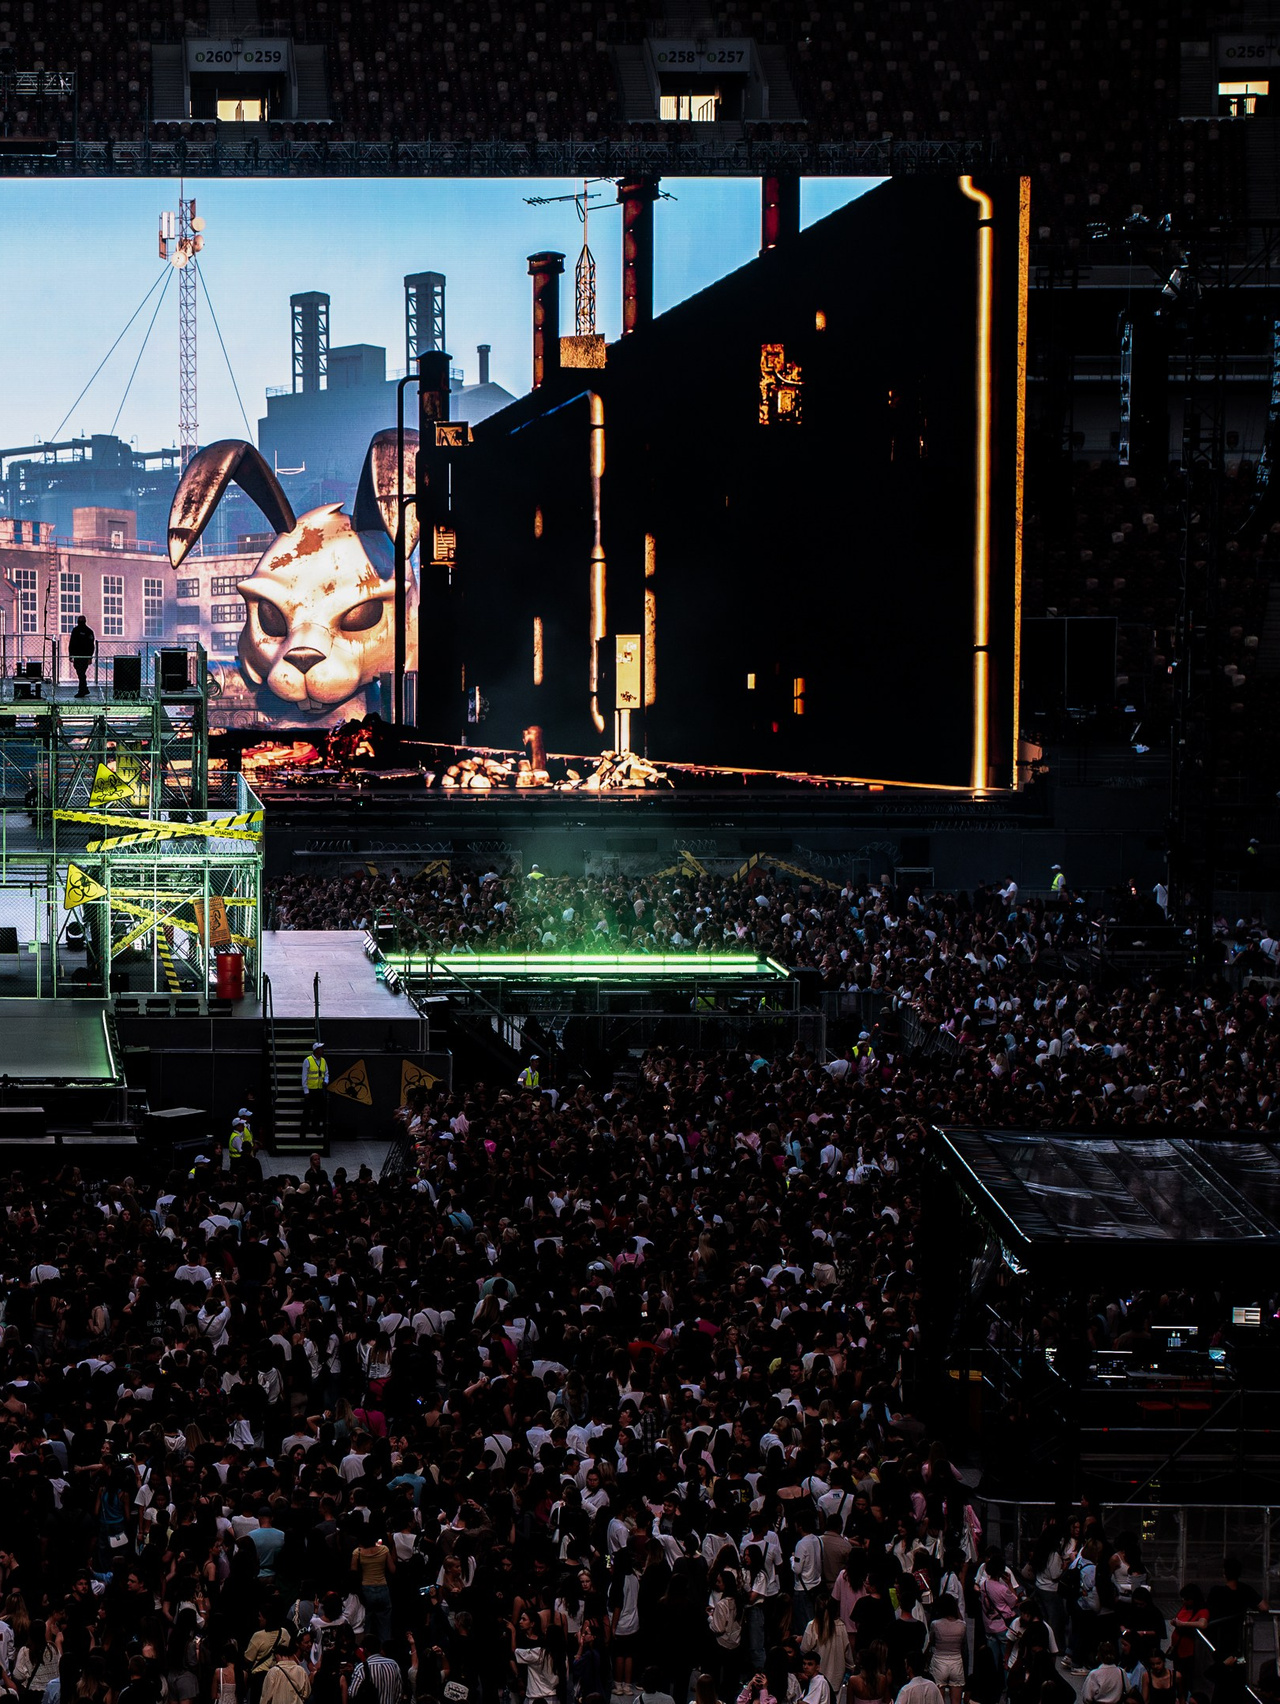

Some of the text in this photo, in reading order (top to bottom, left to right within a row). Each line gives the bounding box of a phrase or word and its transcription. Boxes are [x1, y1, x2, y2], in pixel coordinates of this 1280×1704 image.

[206, 50, 233, 63] 260
[254, 50, 282, 63] 259
[668, 51, 696, 63] 258
[717, 51, 745, 63] 257
[1236, 45, 1266, 58] 256
